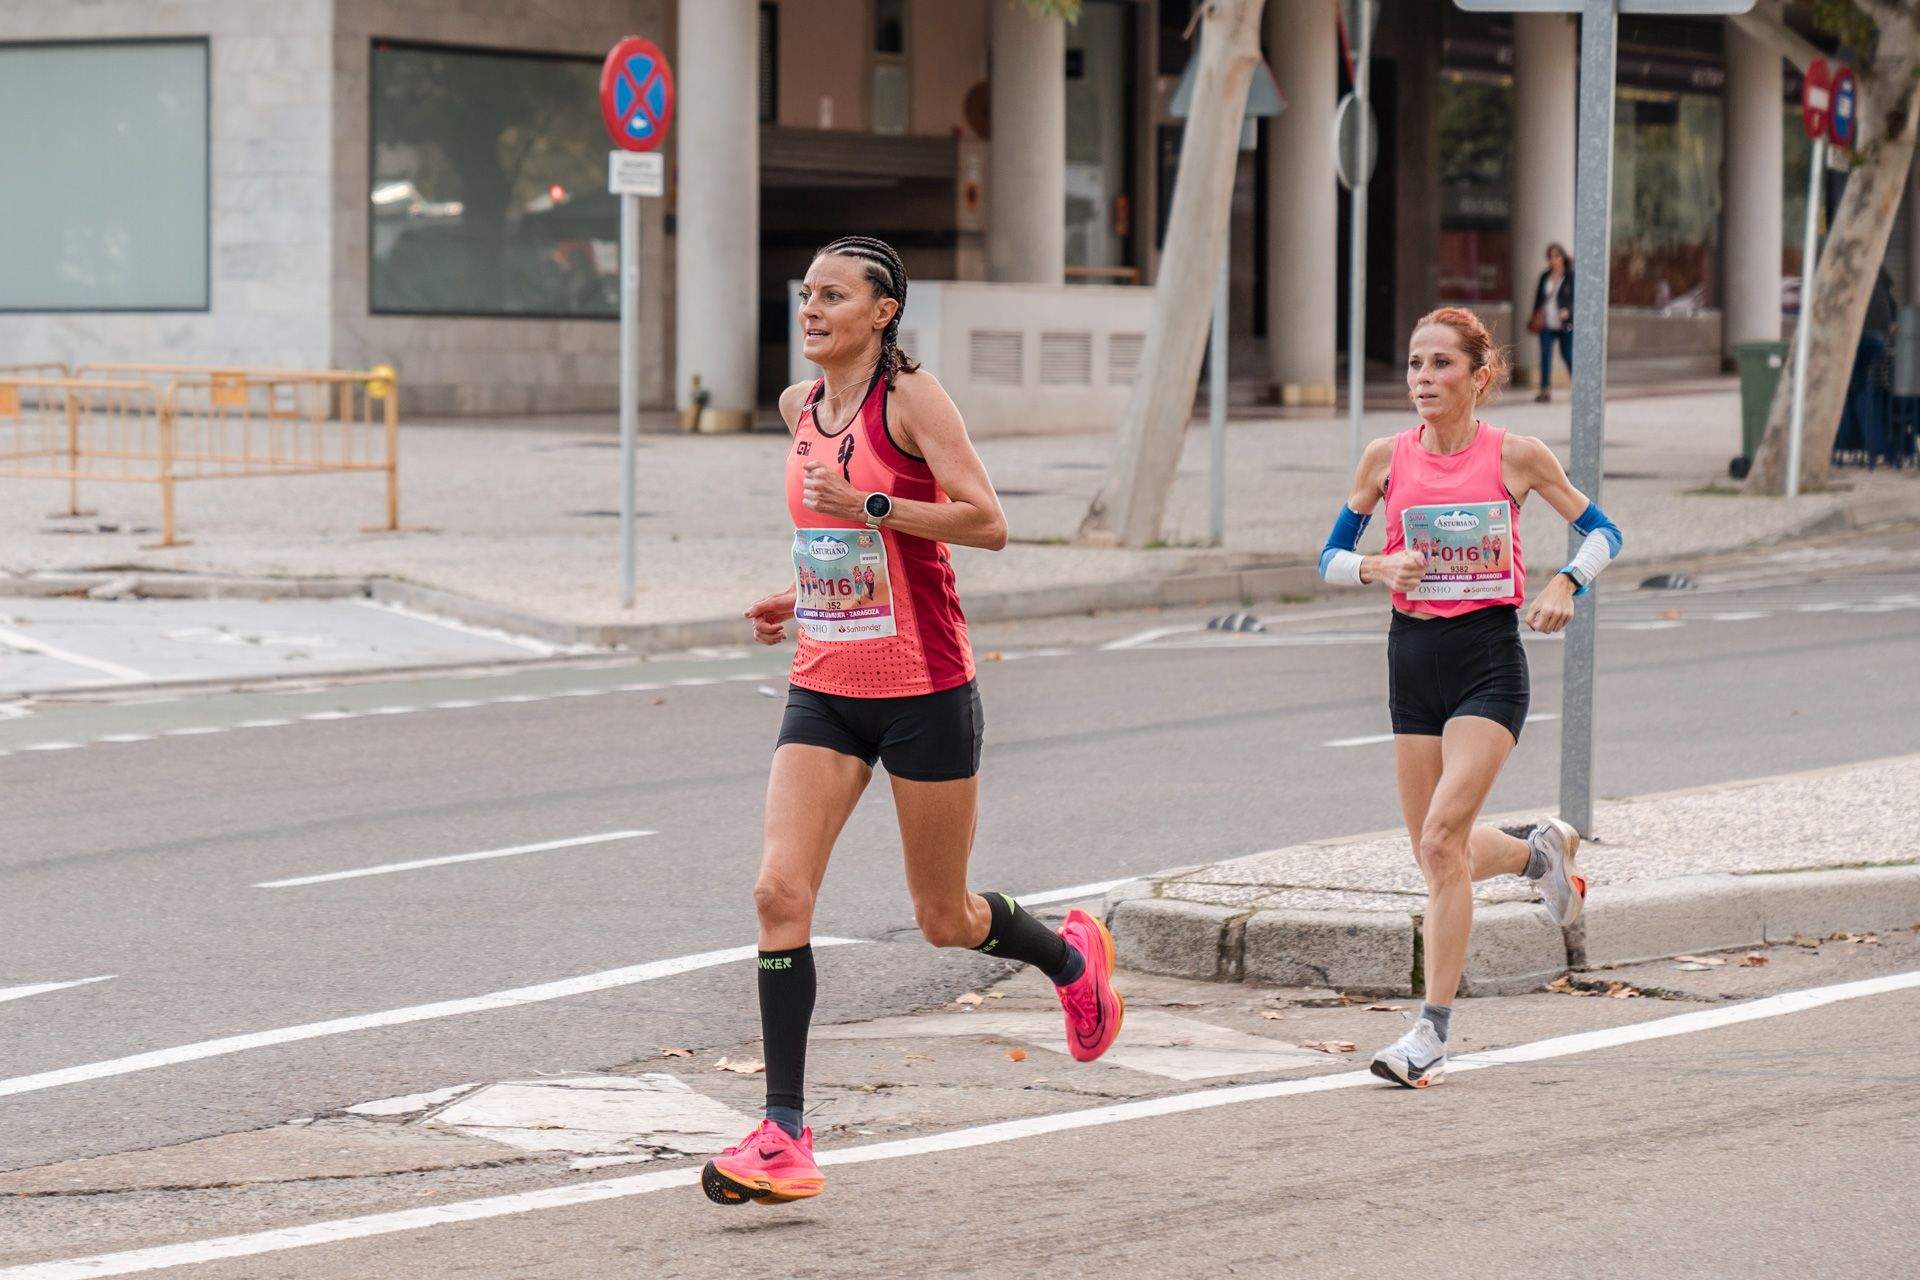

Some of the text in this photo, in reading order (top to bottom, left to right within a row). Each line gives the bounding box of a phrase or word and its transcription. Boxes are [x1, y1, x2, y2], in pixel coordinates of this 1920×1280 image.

[1437, 519, 1477, 528] ASTURIANA
[812, 544, 847, 555] ASTURIANA
[1441, 546, 1480, 561] 016
[1476, 572, 1503, 580] ZARAGOZA
[818, 578, 852, 596] 016
[1418, 586, 1451, 594] OYSHO
[849, 609, 880, 618] ZARAGOZA
[847, 624, 882, 633] Santander
